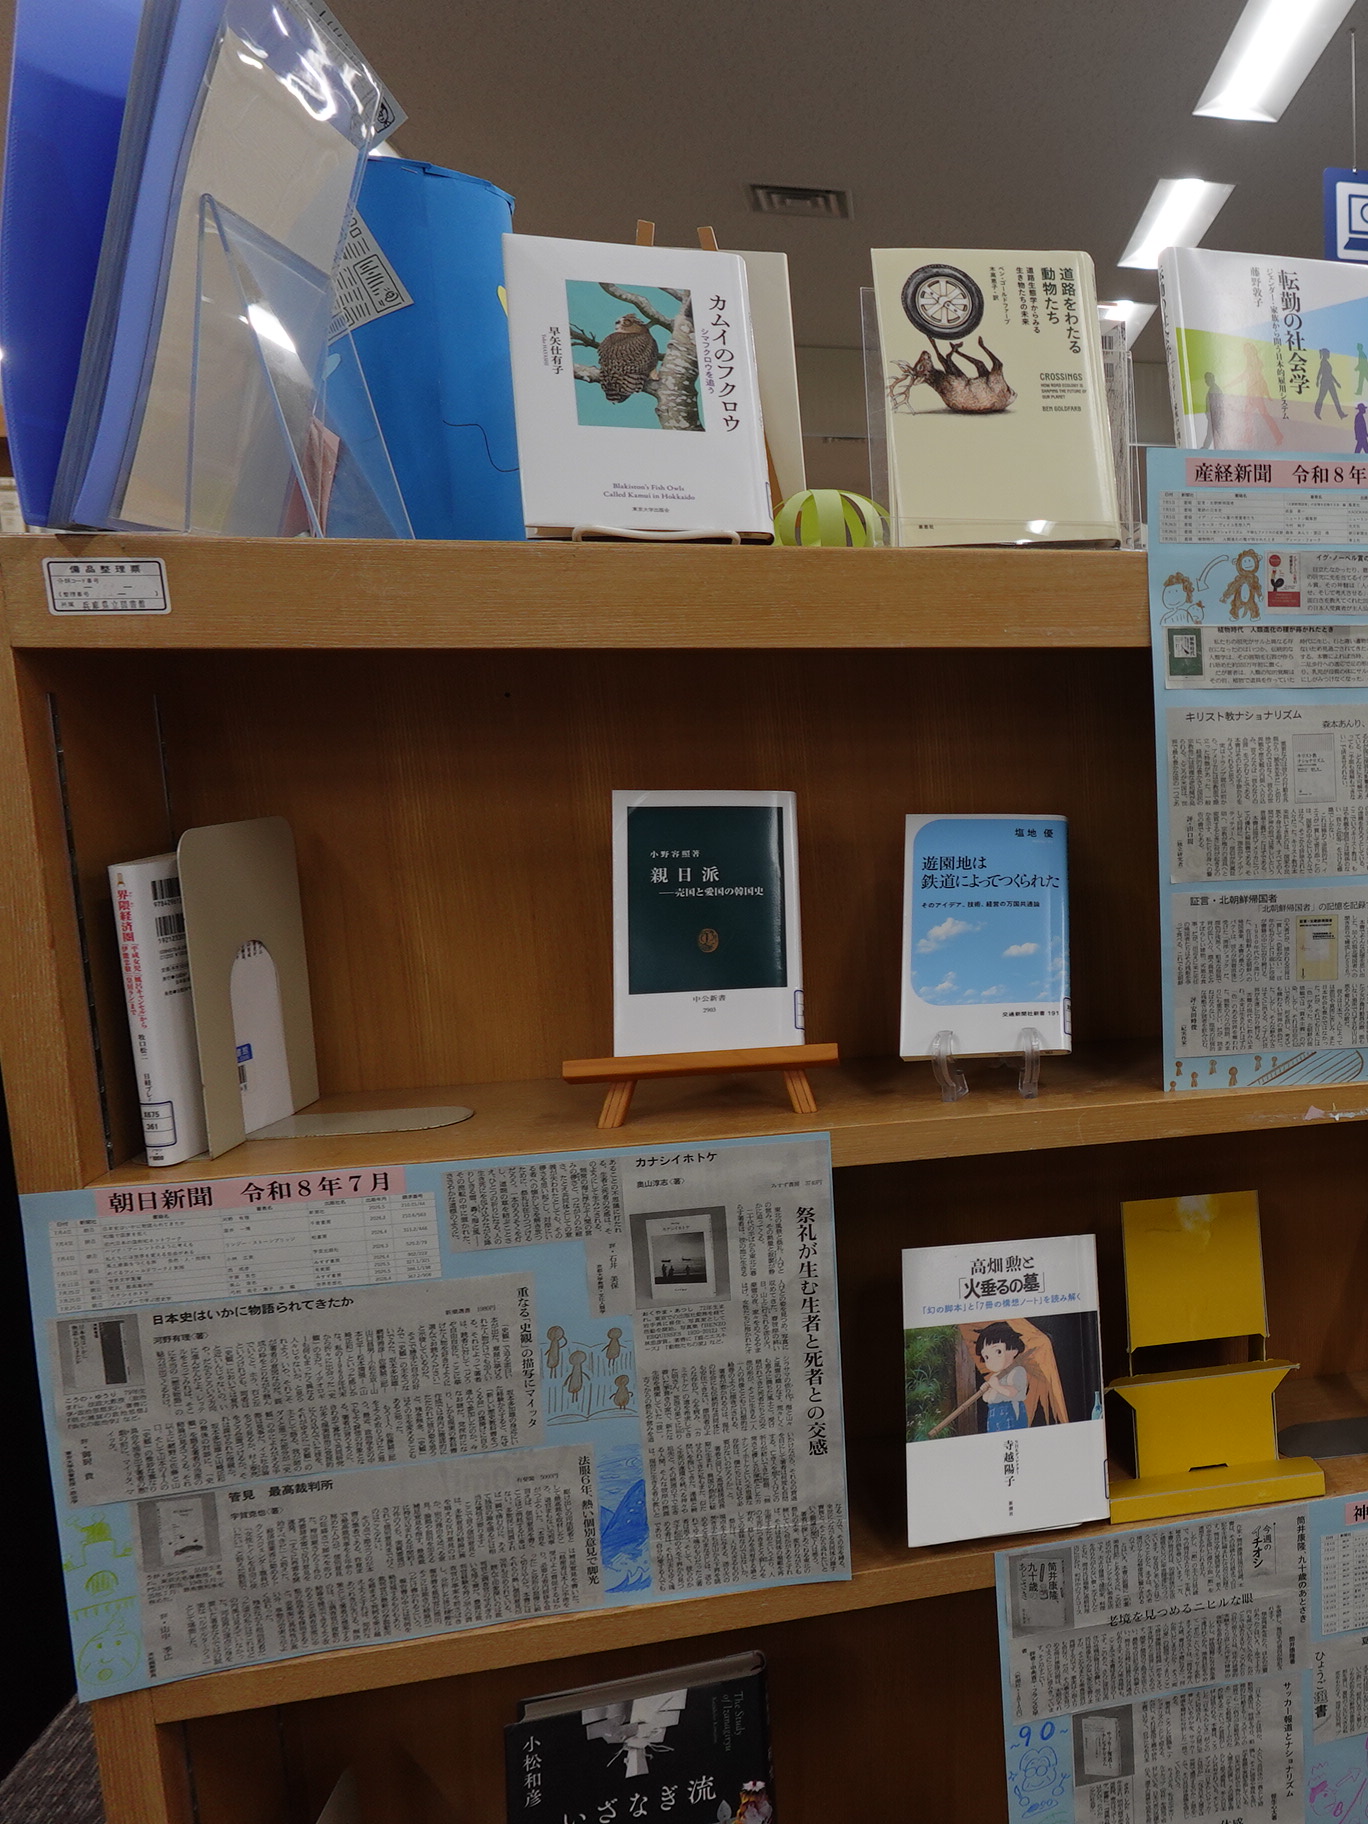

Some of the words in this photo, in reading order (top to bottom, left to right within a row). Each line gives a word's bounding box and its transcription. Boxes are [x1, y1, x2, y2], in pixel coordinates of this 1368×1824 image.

[1015, 266, 1030, 327] 生き物たちの未来
[1026, 267, 1041, 334] 道路生態学からみる
[1040, 267, 1061, 325] 動物たち
[1059, 267, 1082, 355] 道路をわたる
[1265, 267, 1290, 421] ジェンダー・家族から問う日本的雇用システム
[1277, 269, 1310, 395] 転勤の社会学
[548, 326, 565, 375] 早矢仕有子
[700, 327, 716, 395] シマフクロウを追う
[708, 293, 741, 433] カムイのフクロウ
[1039, 372, 1083, 382] CROSSINGS
[1194, 464, 1273, 486] 産経新聞
[69, 564, 141, 574] 備品整理票
[1185, 709, 1302, 723] キリスト教ナショナリズム
[1014, 828, 1037, 838] 塩地
[649, 849, 701, 859] 小野容照著
[921, 855, 988, 872] 遊園地は
[649, 866, 720, 884] 親日派
[920, 873, 1060, 890] 鉄道によってつくられた
[921, 900, 1041, 909] そのアイデア、技術、経営の万国共通論
[692, 993, 727, 1003] 中公新書
[634, 1150, 719, 1169] カナシイホトケ
[108, 1186, 214, 1213] 朝日新聞
[240, 1171, 391, 1203] 令和8年7月
[969, 1255, 1036, 1276] 高畑勲と
[957, 1271, 1046, 1301] 「火垂るの墓」
[152, 1297, 355, 1326] 日本史はいかに物語られてきたか
[921, 1292, 1083, 1316] 「幻の脚本」と「7冊の構想ノート」を読み解く
[794, 1206, 830, 1457] 祭礼が生む生者と死者との交感
[516, 1286, 539, 1429] 重なる「史観」の描写にマイッタ
[1002, 1439, 1015, 1488] 寺越陽子
[268, 1479, 334, 1498] 最高裁判所
[577, 1455, 601, 1586] 法服6年、熱い個別意見で脚光
[1262, 1524, 1273, 1552] 今週の
[1252, 1526, 1265, 1570] イチオシ
[1296, 1515, 1308, 1624] 筒井康隆、九十歳のあとさき
[1108, 1592, 1256, 1627] 老境を見つめるニヒルな眼
[1283, 1682, 1295, 1798] サッカー報道とナショナリズム
[522, 1735, 543, 1809] 小松和彦
